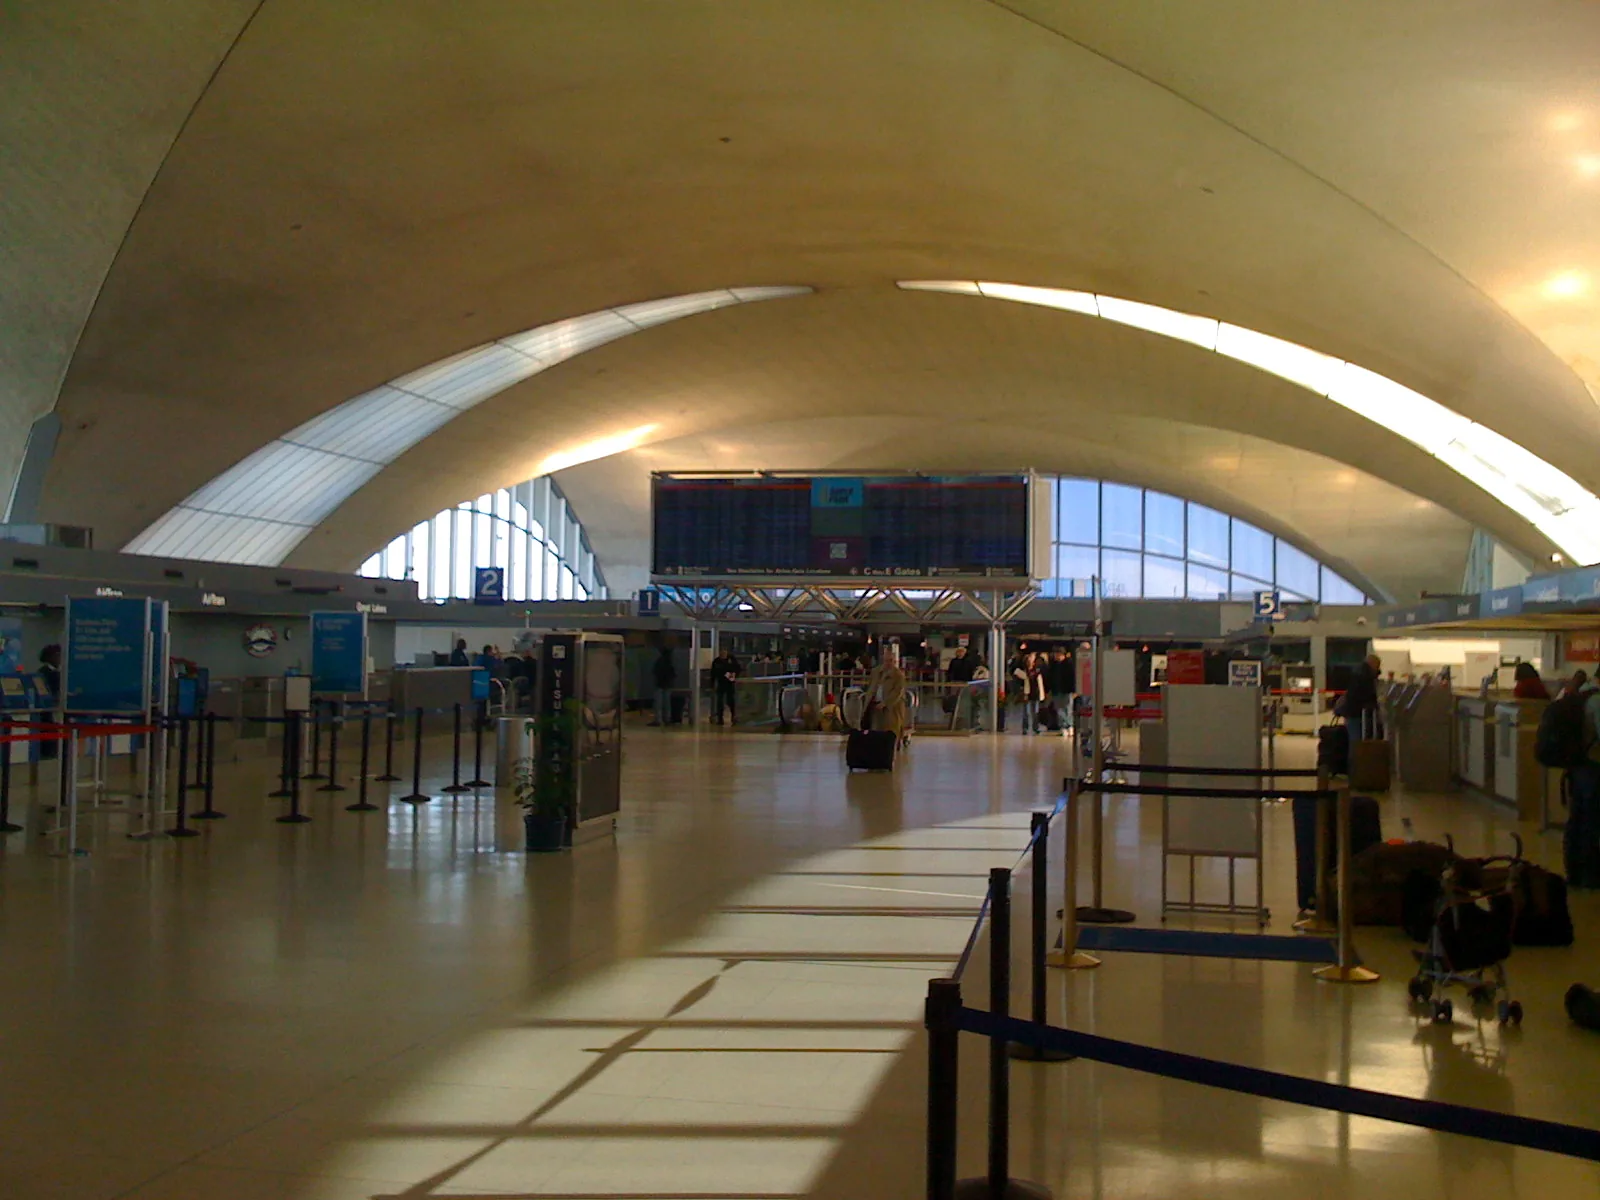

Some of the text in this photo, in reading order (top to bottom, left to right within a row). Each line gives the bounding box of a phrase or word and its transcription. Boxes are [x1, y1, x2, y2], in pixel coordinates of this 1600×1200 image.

[894, 567, 921, 576] Gates
[481, 572, 498, 595] 2
[646, 591, 652, 610] 1
[1260, 591, 1275, 614] 5
